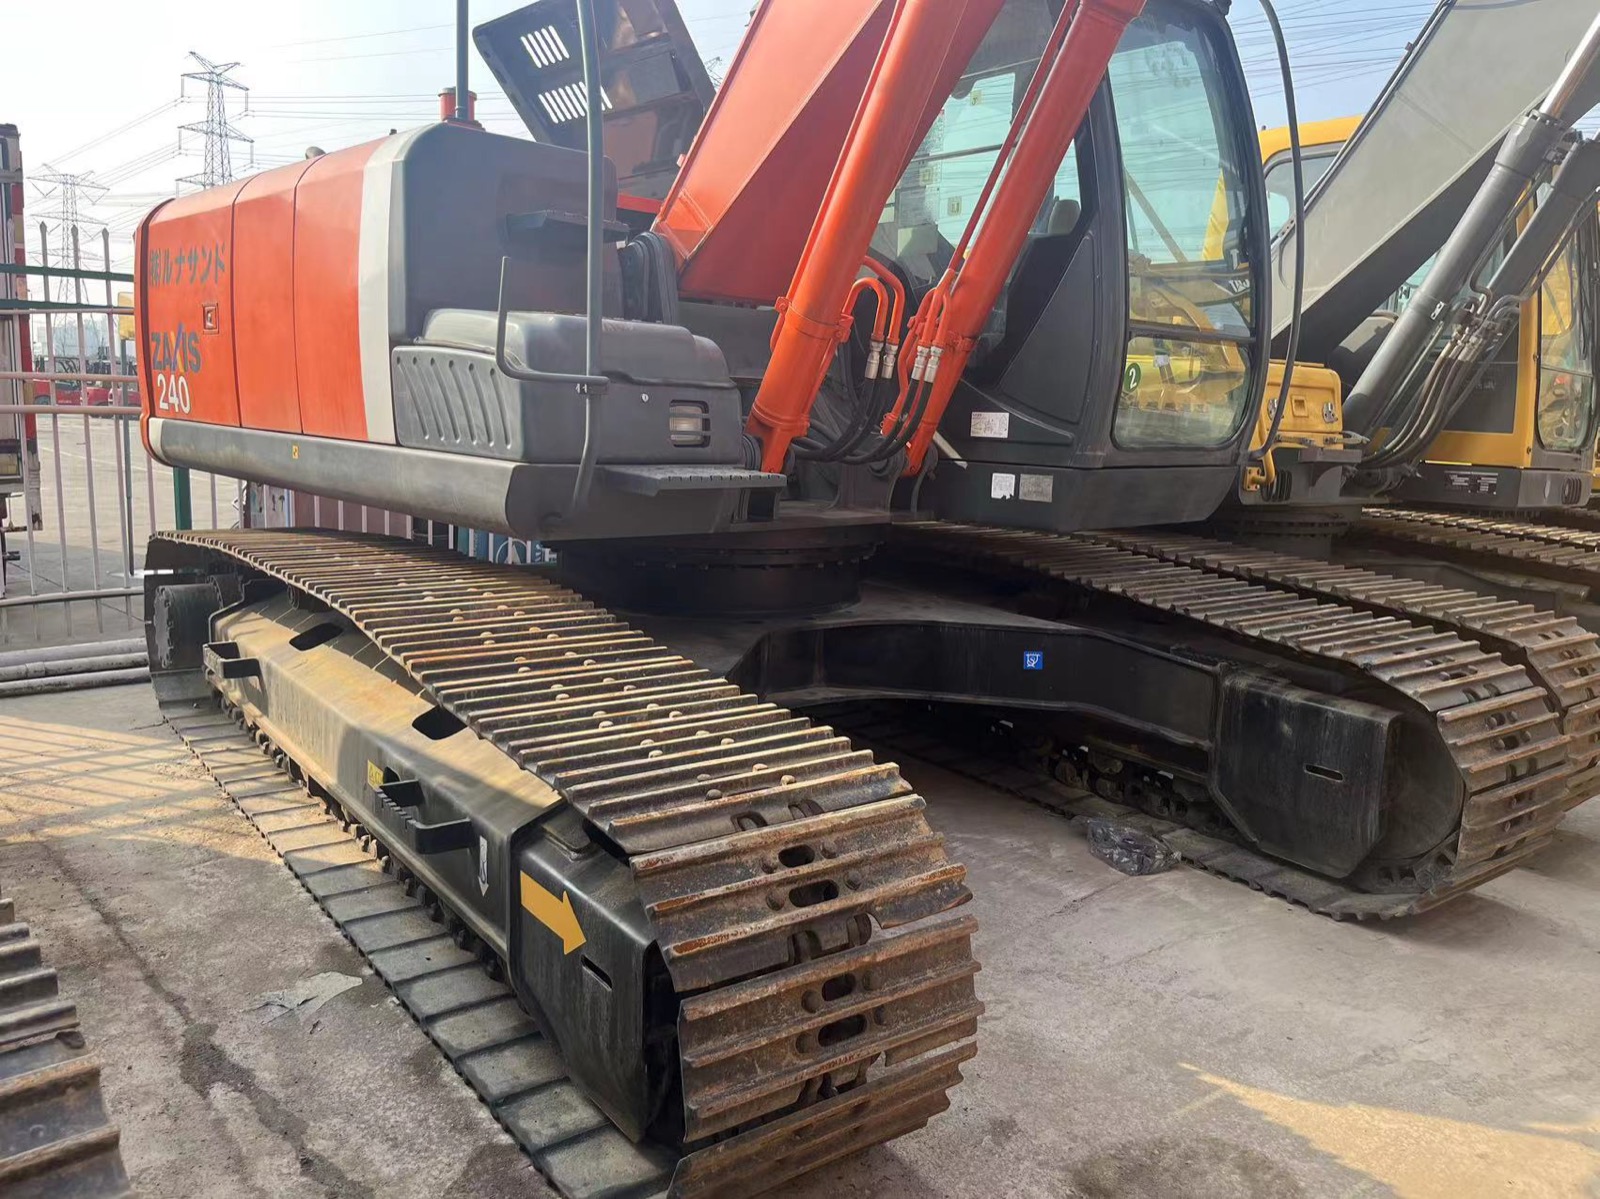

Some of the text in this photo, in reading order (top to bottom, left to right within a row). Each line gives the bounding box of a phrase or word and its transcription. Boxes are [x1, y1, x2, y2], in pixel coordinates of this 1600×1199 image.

[151, 322, 202, 375] ZAXIS
[157, 373, 192, 414] 240
[1129, 367, 1137, 389] 2
